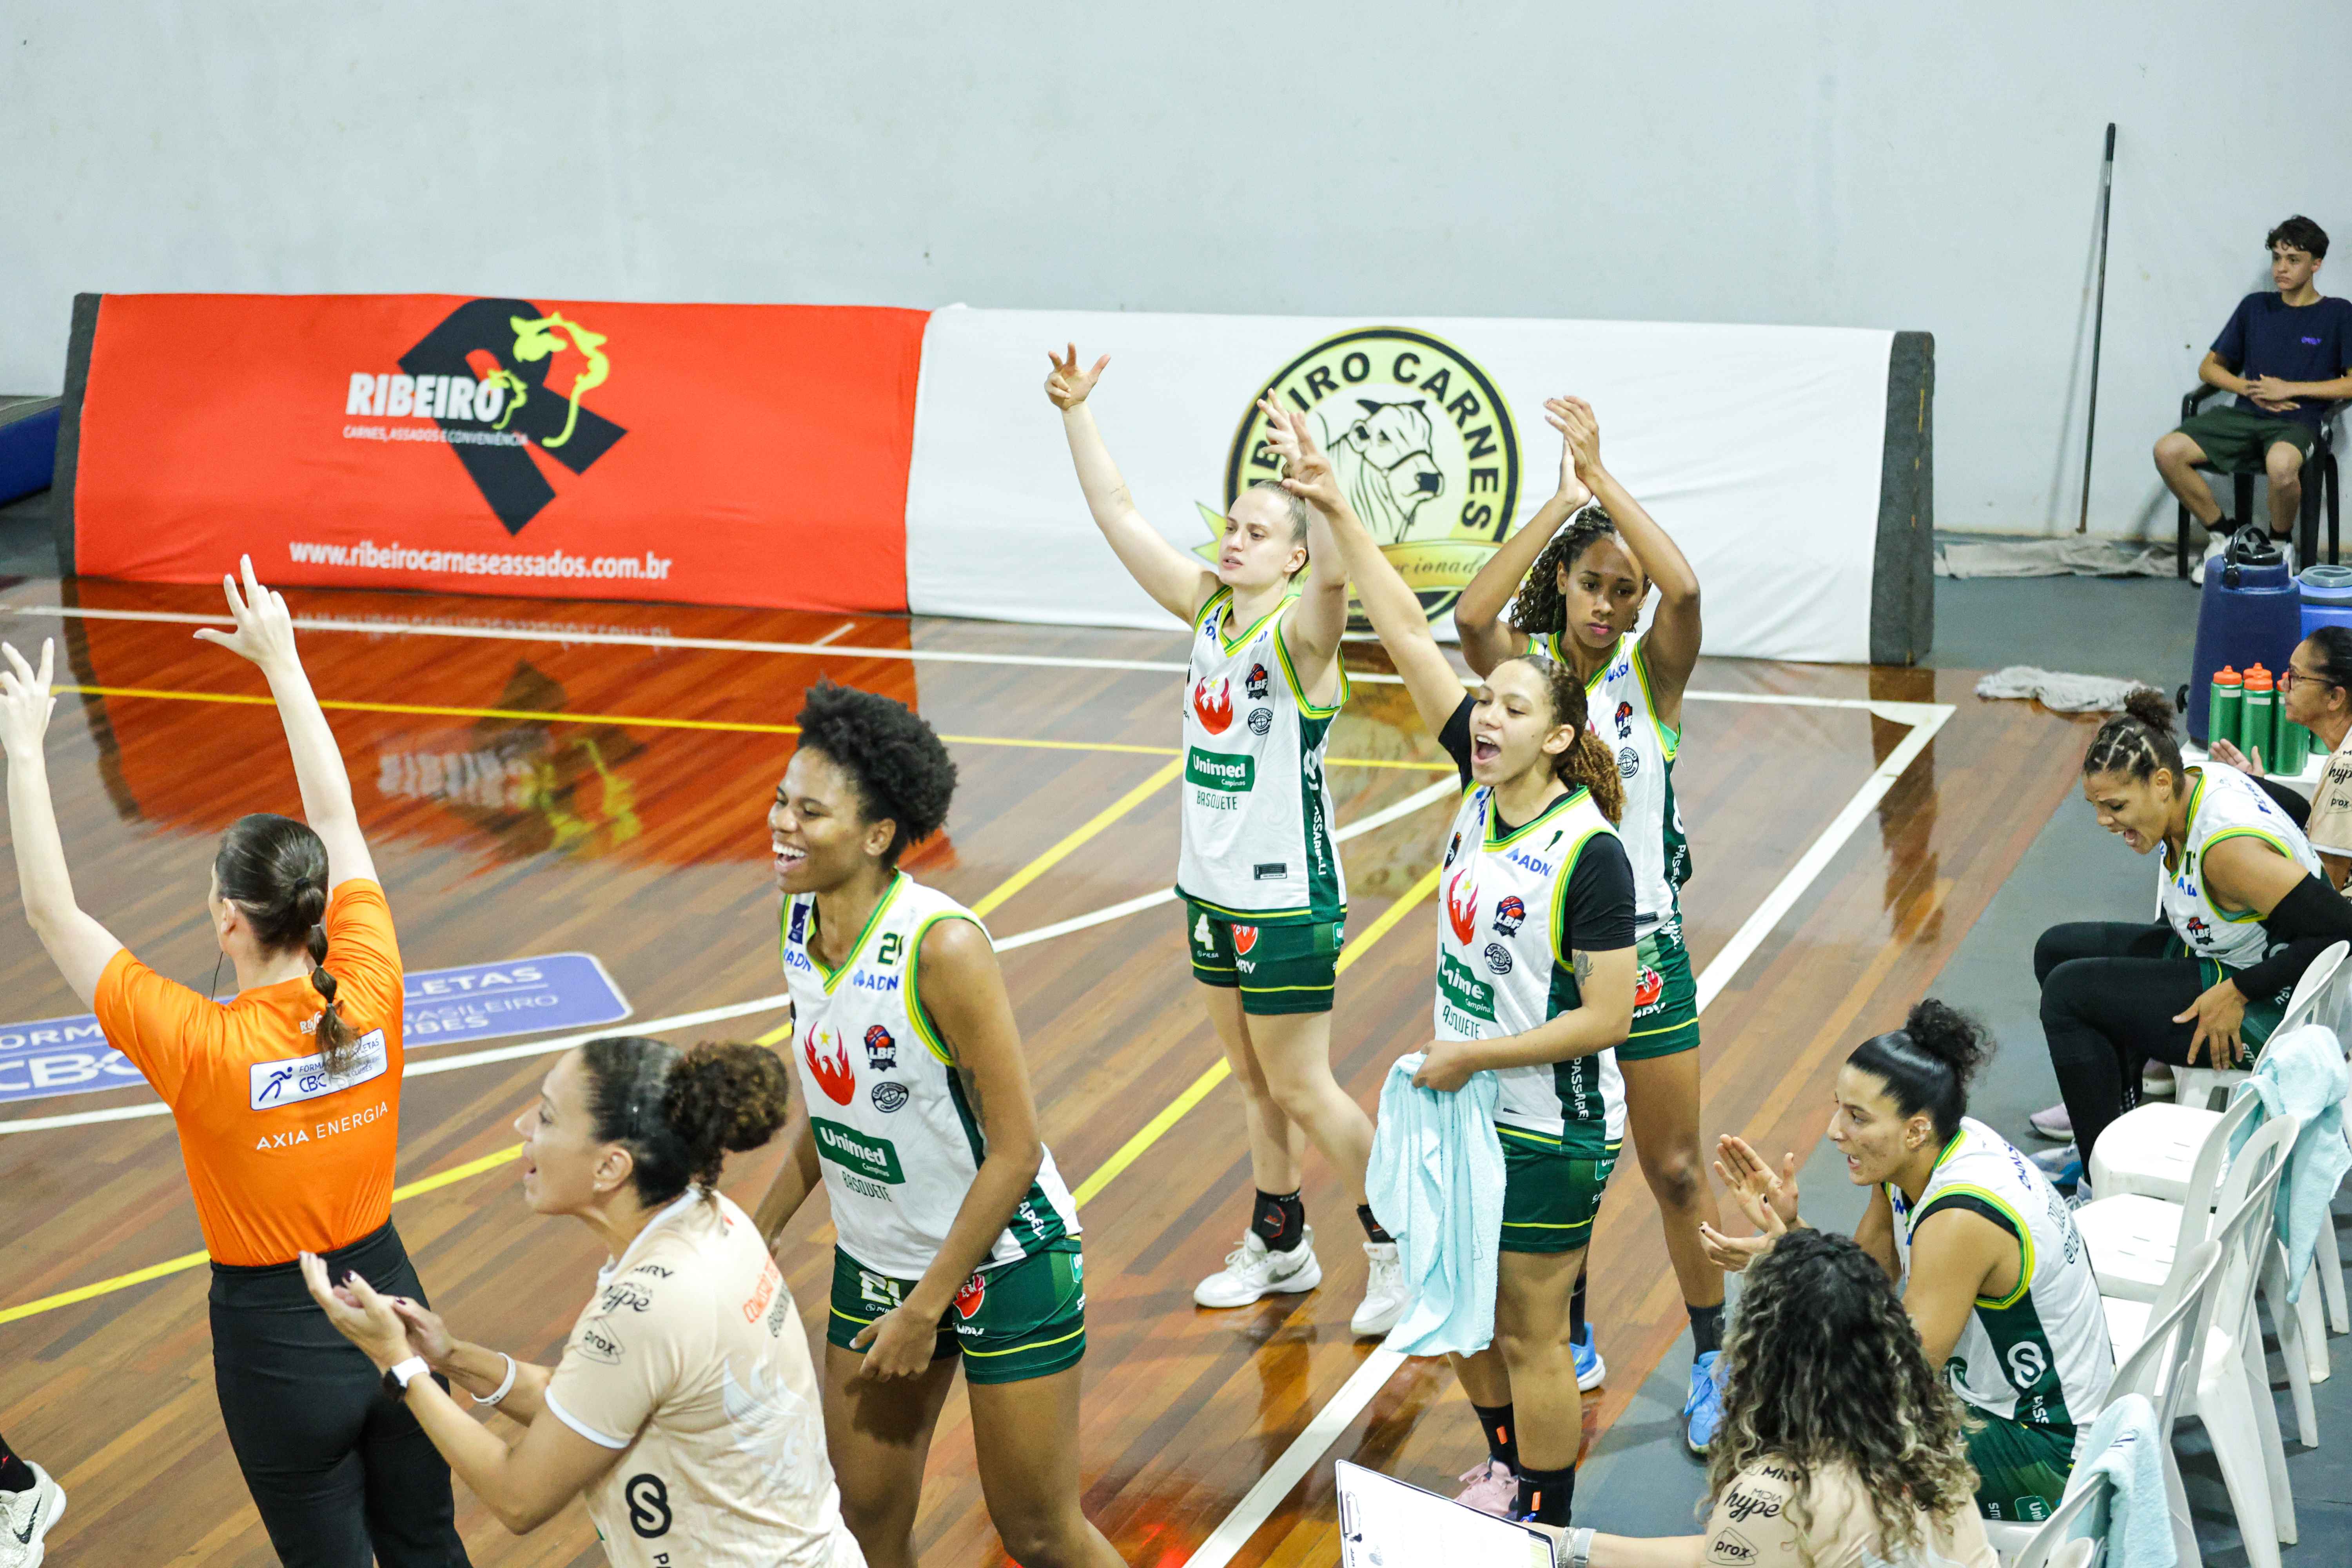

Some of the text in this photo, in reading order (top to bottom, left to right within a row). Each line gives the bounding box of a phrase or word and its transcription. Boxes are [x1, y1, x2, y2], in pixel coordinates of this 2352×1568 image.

[345, 372, 505, 422] RIBEIRO
[343, 425, 388, 443] CARNES,
[391, 428, 440, 443] ASSADOS
[1392, 352, 1499, 531] CARNES
[290, 540, 672, 580] www.ribeirocarneseassados.com.br
[1248, 679, 1268, 691] LBF
[1618, 715, 1632, 731] LBF
[1193, 754, 1245, 778] Unimed
[1221, 779, 1246, 787] Campinas
[1197, 791, 1237, 810] BASQUETE
[2330, 798, 2350, 808] prox
[1517, 855, 1552, 877] ADN
[1495, 911, 1523, 929] LBF
[1194, 913, 1214, 951] 4
[866, 975, 898, 991] ADN
[1465, 998, 1493, 1014] Campina
[868, 1047, 896, 1060] LBF
[1571, 1057, 1589, 1120] PASSARE
[256, 1101, 388, 1150] AXIA ENERGIA
[820, 1127, 887, 1167] Unimed
[842, 1171, 893, 1202] BASQUETE
[1723, 1482, 1783, 1522] hype
[1714, 1541, 1750, 1558] prox
